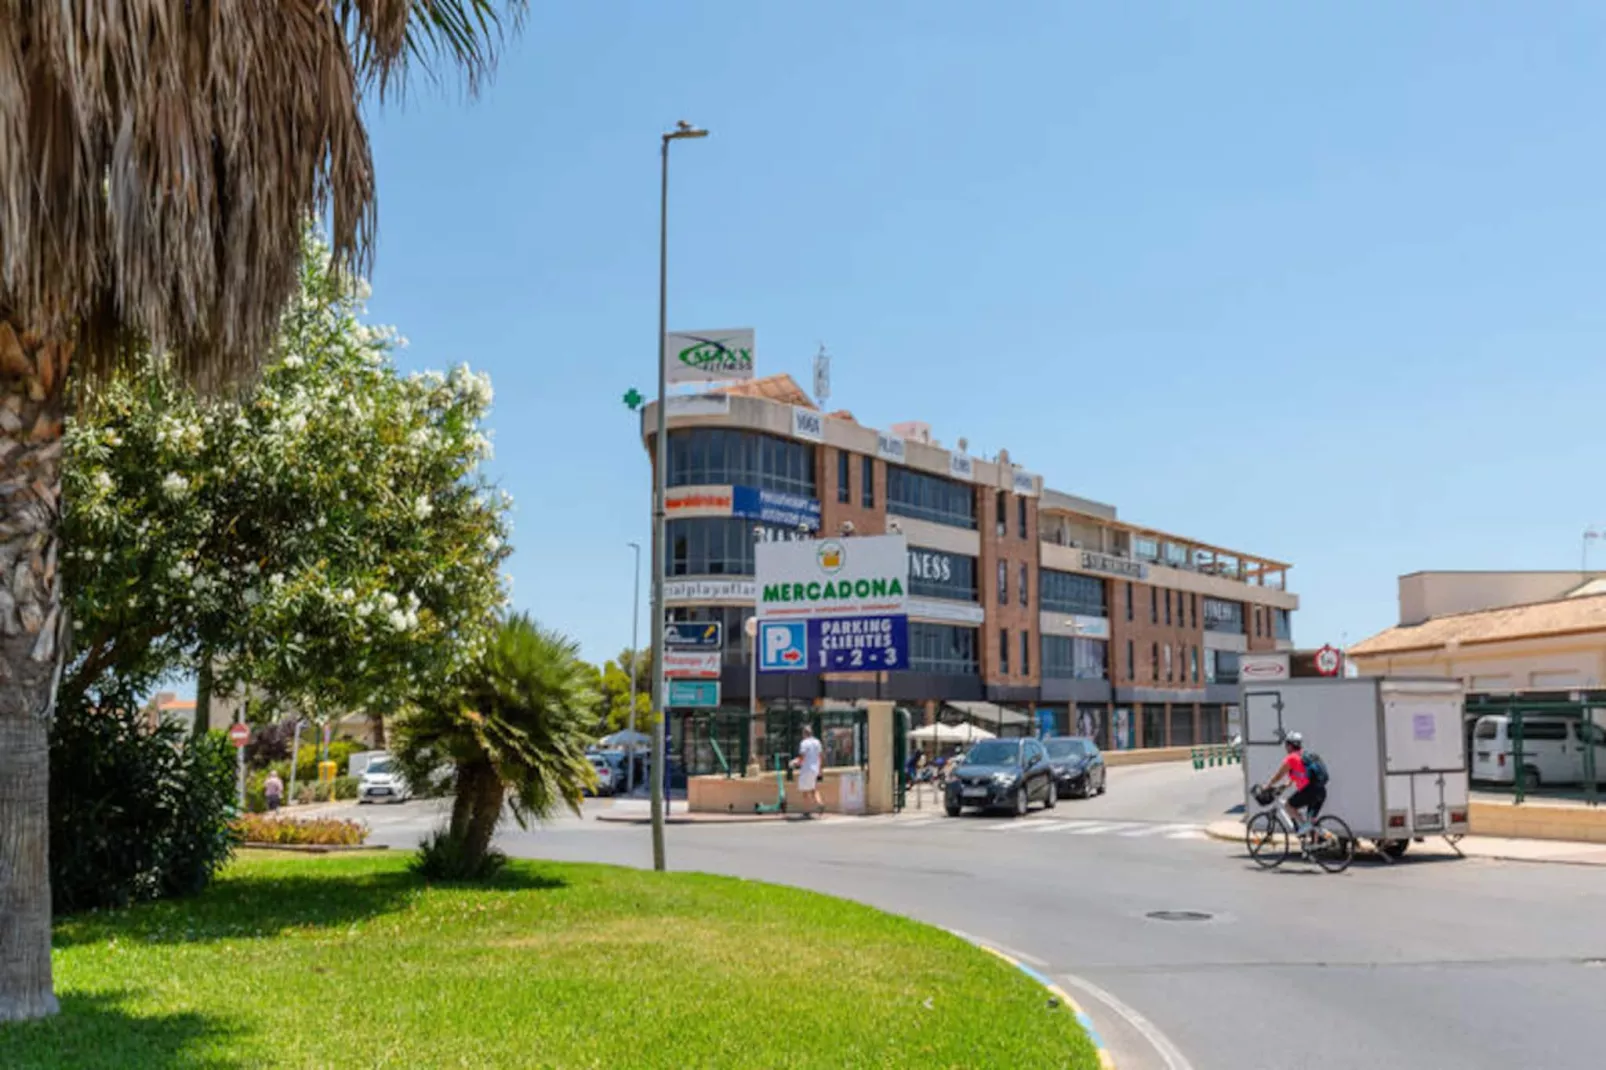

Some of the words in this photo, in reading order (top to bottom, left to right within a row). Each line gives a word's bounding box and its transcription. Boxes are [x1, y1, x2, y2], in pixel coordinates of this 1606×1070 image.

[904, 551, 951, 580] NESS
[762, 577, 904, 602] MERCADONA
[821, 618, 892, 636] PARKING
[766, 626, 792, 664] P
[820, 633, 893, 650] CLIENTES
[818, 649, 828, 668] 1
[850, 649, 863, 666] 2
[883, 647, 898, 666] 3
